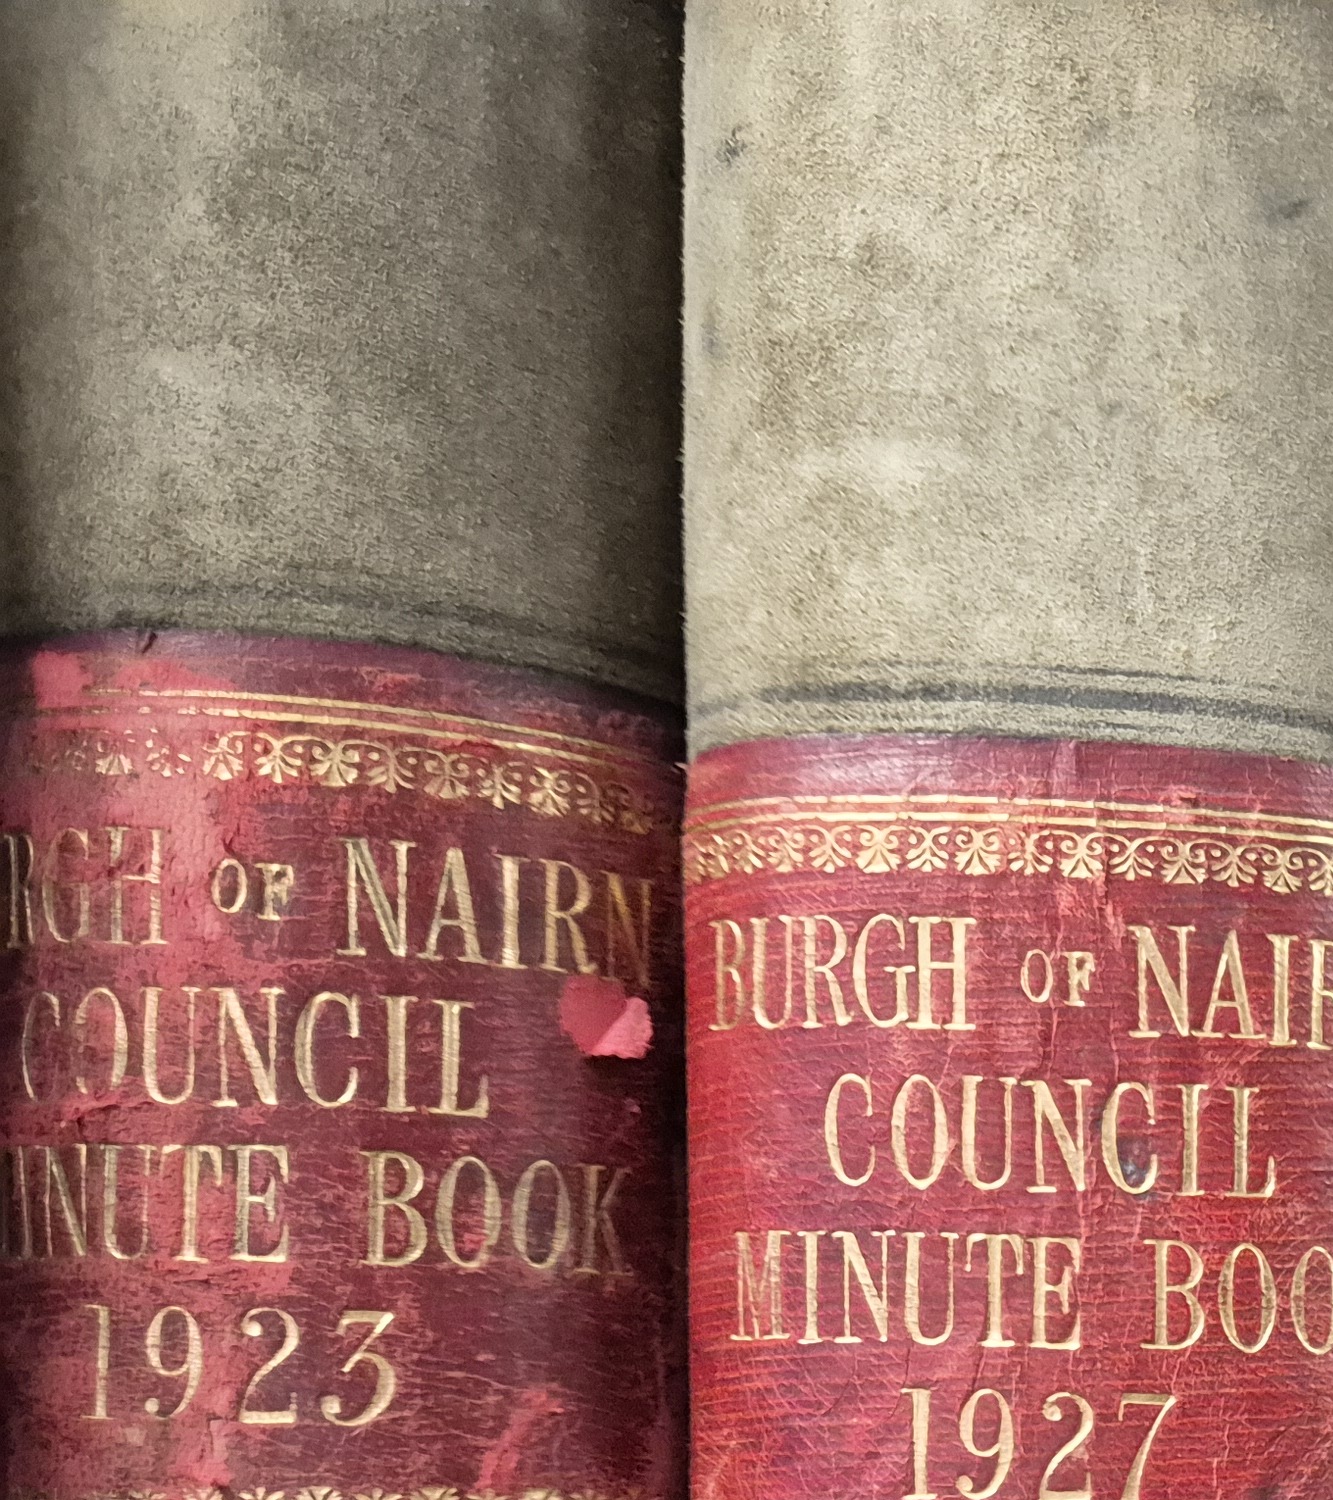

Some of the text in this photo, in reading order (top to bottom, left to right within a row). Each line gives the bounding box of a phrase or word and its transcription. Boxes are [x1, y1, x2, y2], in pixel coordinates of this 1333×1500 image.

[212, 859, 294, 921] OF
[339, 837, 654, 987] NAIRN
[709, 912, 977, 1031] BURGH
[1020, 948, 1093, 1006] OF
[21, 986, 490, 1117] COUNCIL
[825, 1072, 1276, 1198] COUNCIL
[0, 1143, 632, 1277] INUTE BOOK
[730, 1230, 1083, 1350] MINUTE
[83, 1304, 396, 1425] 1923
